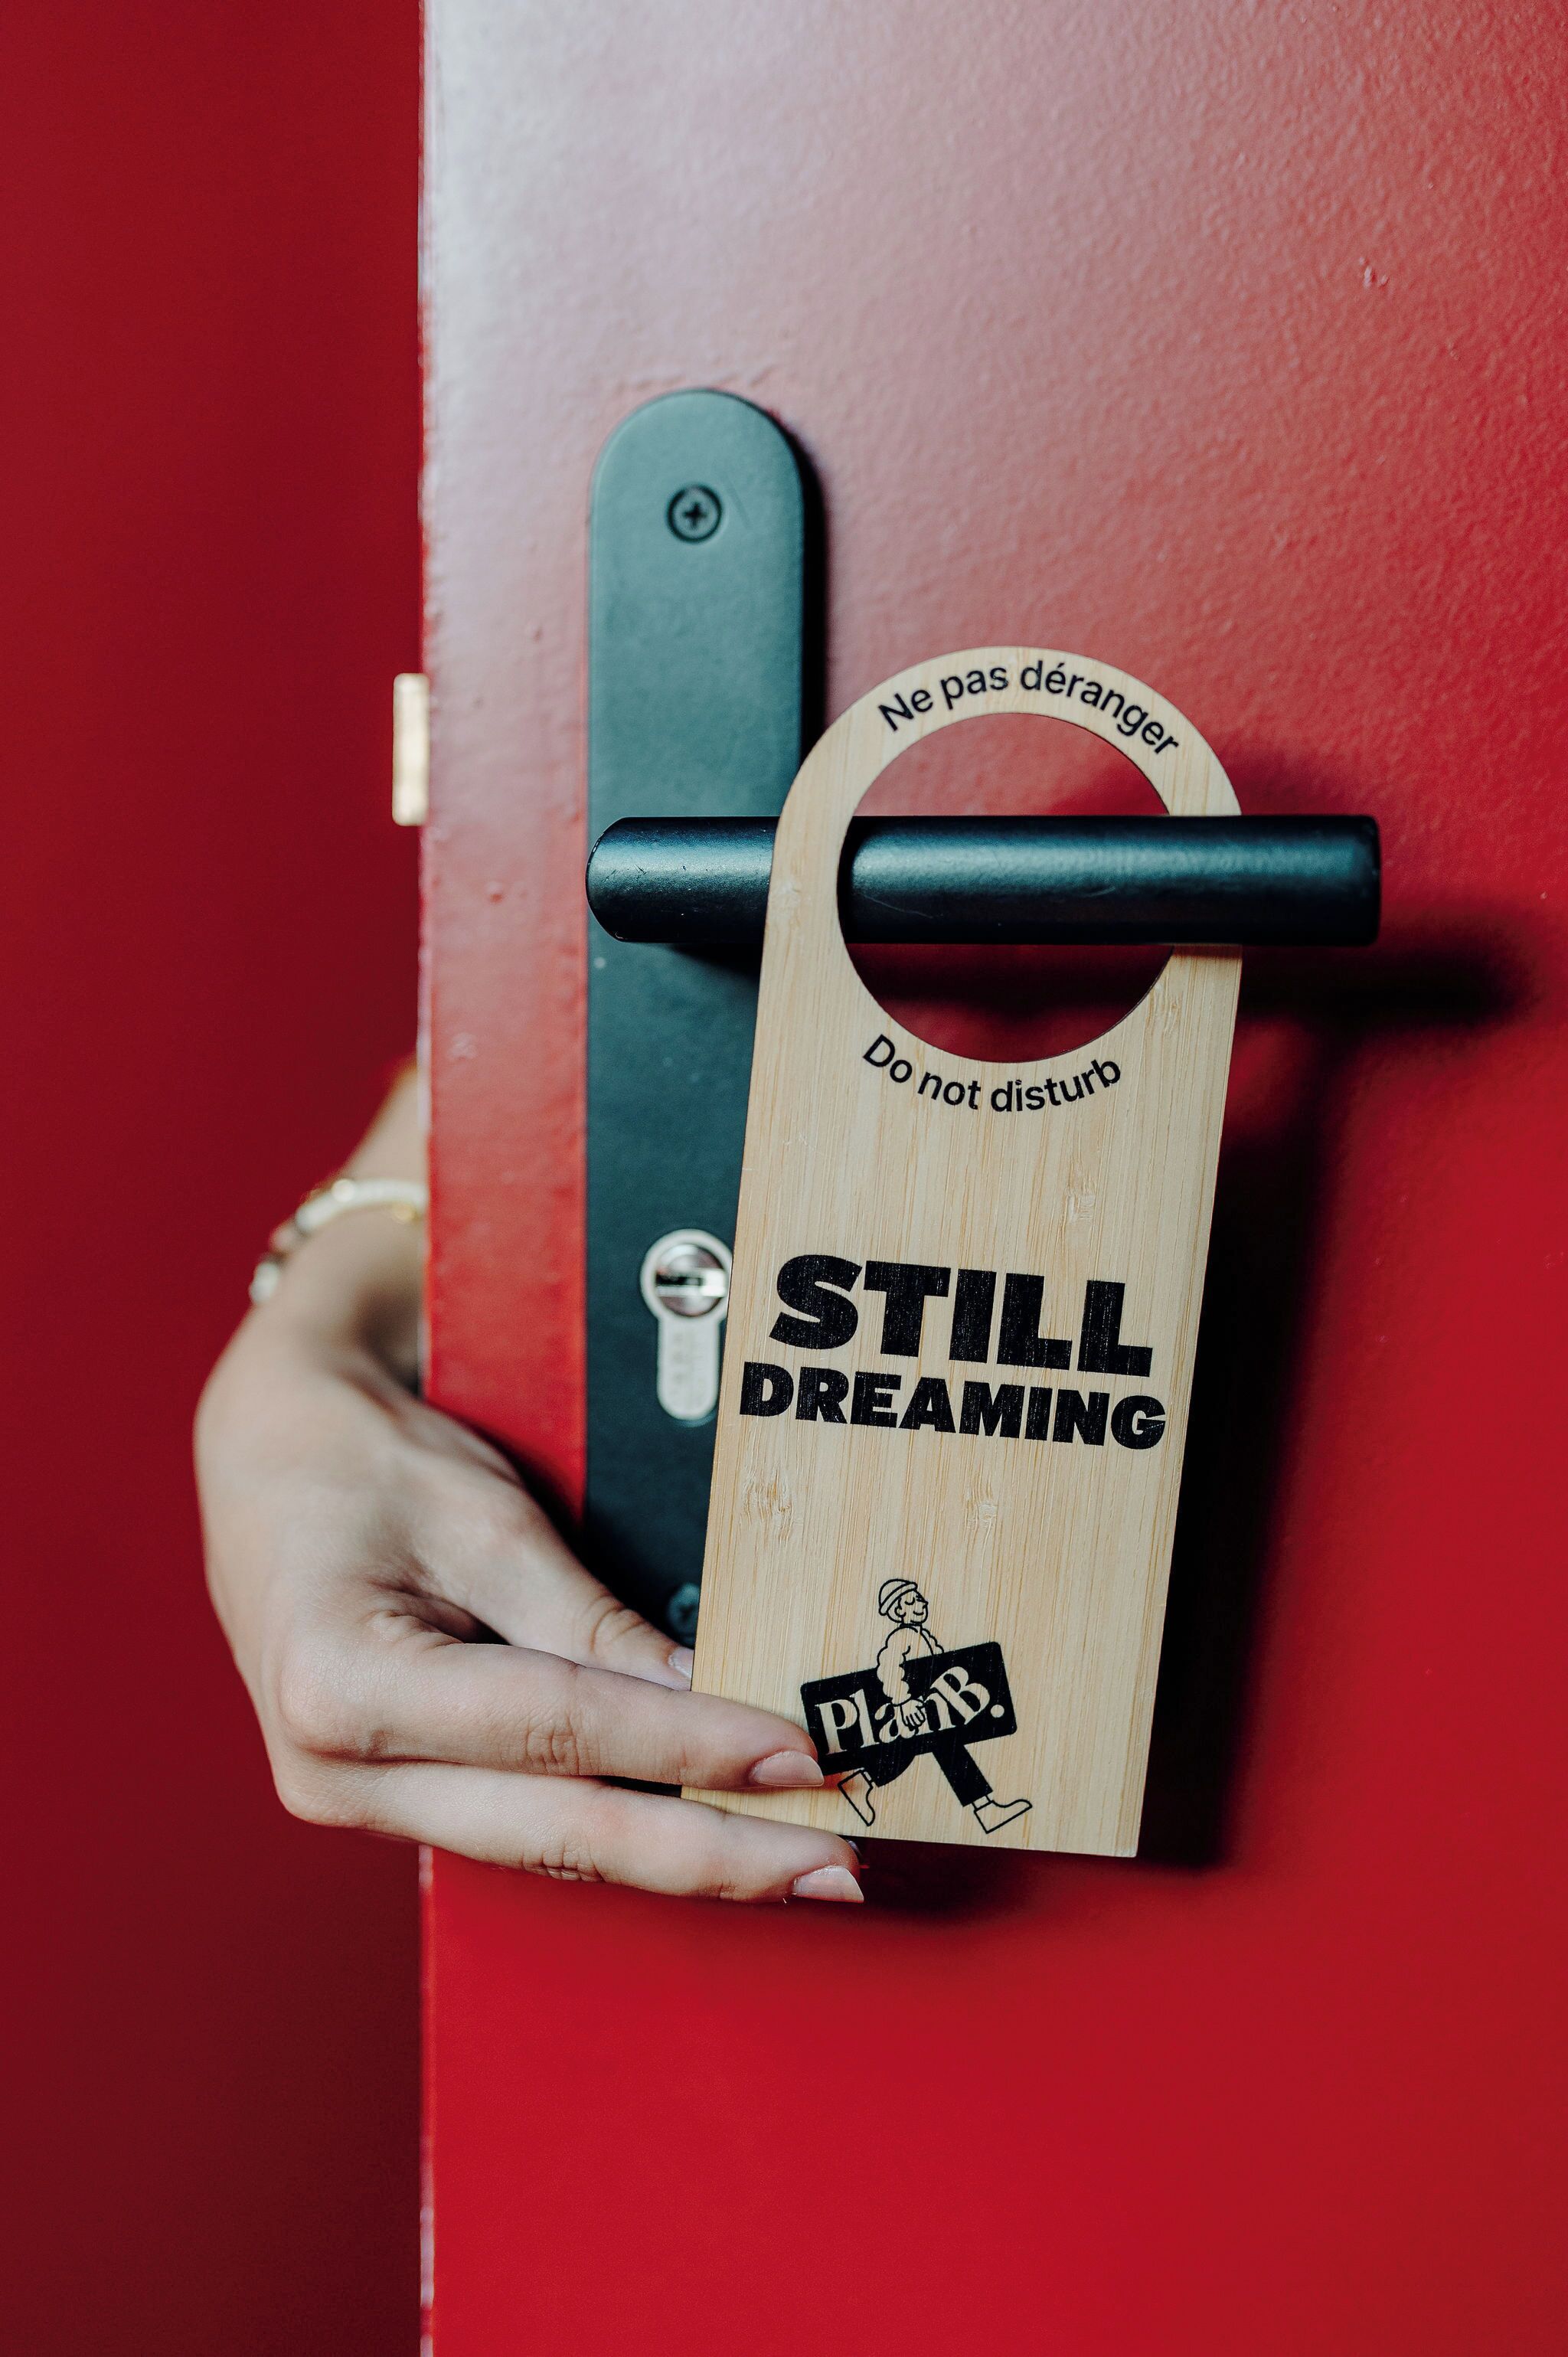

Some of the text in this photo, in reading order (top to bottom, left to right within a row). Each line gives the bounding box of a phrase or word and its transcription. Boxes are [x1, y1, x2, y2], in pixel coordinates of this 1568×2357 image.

[877, 660, 1179, 755] Ne pas déranger
[862, 1034, 1122, 1113] Do not disturb
[769, 1254, 1154, 1378] STILL
[739, 1361, 1166, 1450] DREAMING
